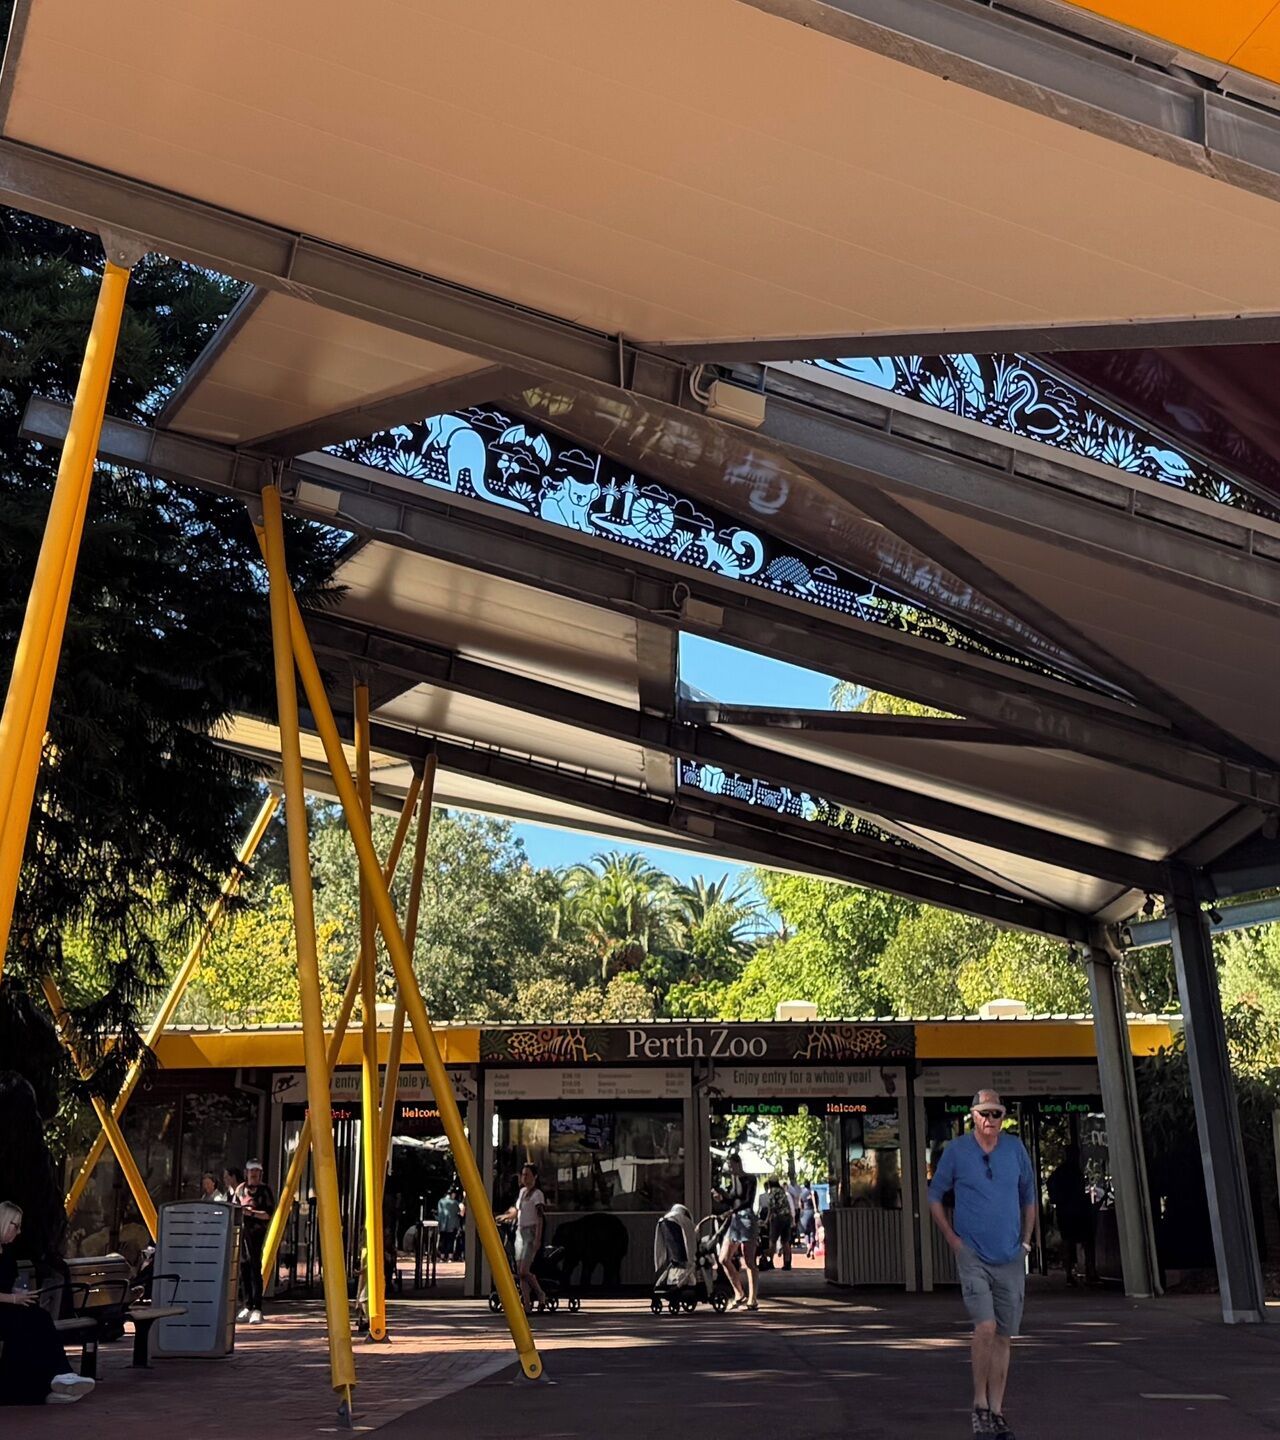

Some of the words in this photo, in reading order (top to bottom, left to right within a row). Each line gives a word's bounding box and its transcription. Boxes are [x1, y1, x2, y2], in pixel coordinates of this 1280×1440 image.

[626, 1028, 704, 1058] Perth
[710, 1030, 768, 1058] Zoo
[335, 1075, 360, 1091] entry
[733, 1069, 759, 1085] Enjoy
[761, 1071, 787, 1085] entry
[789, 1070, 803, 1083] for
[814, 1070, 845, 1083] whole
[731, 1103, 755, 1113] Lane
[945, 1102, 968, 1112] Lane
[1038, 1102, 1062, 1112] Lane
